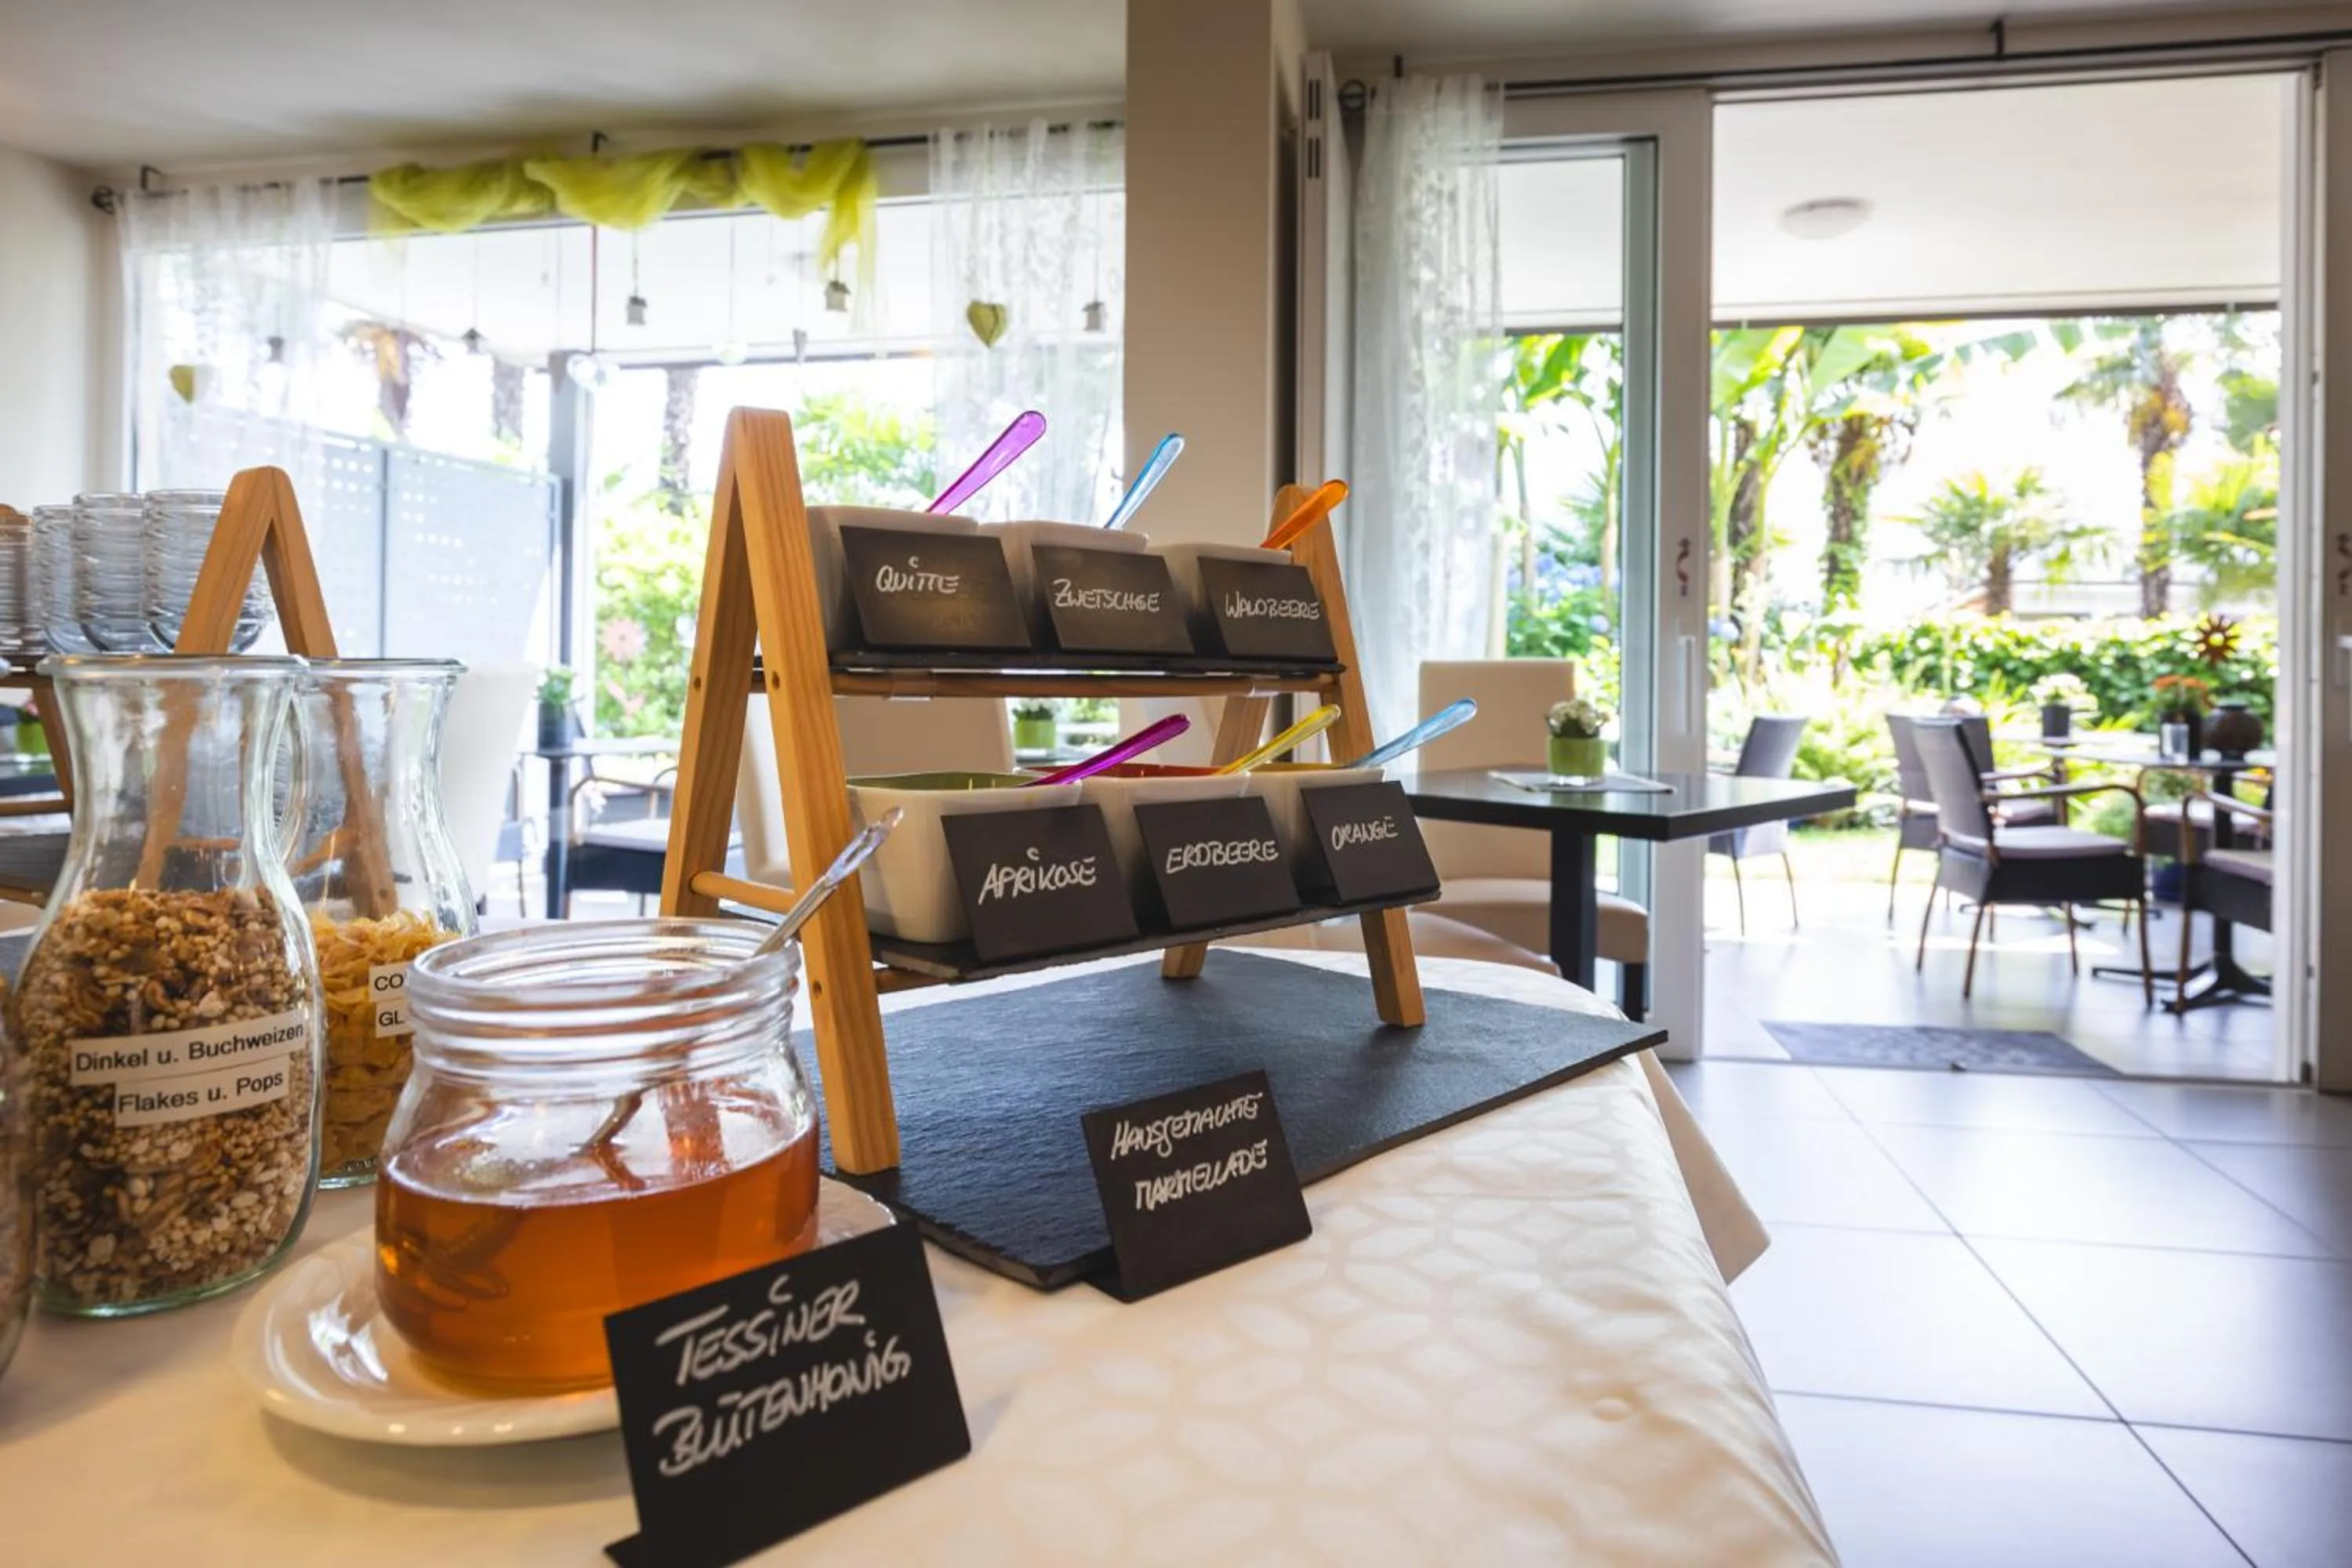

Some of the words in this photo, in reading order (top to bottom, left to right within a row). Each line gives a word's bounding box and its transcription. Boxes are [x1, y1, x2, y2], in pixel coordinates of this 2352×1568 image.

[875, 555, 960, 594] QUITTE
[1052, 577, 1160, 614] ZWETSCHGE
[1225, 590, 1321, 621] WALDBEERE
[1331, 815, 1399, 851] ORANGE
[1166, 839, 1279, 874] ERDBEERE
[978, 848, 1098, 905] APRIKOSE
[373, 972, 405, 992] CO
[74, 1047, 149, 1072] Dinkel
[157, 1045, 180, 1065] u.
[188, 1022, 305, 1060] Buchweizen
[118, 1087, 199, 1114] Flakes
[208, 1087, 228, 1102] u.
[236, 1070, 284, 1098] Pops
[655, 1275, 866, 1386] TESSINER
